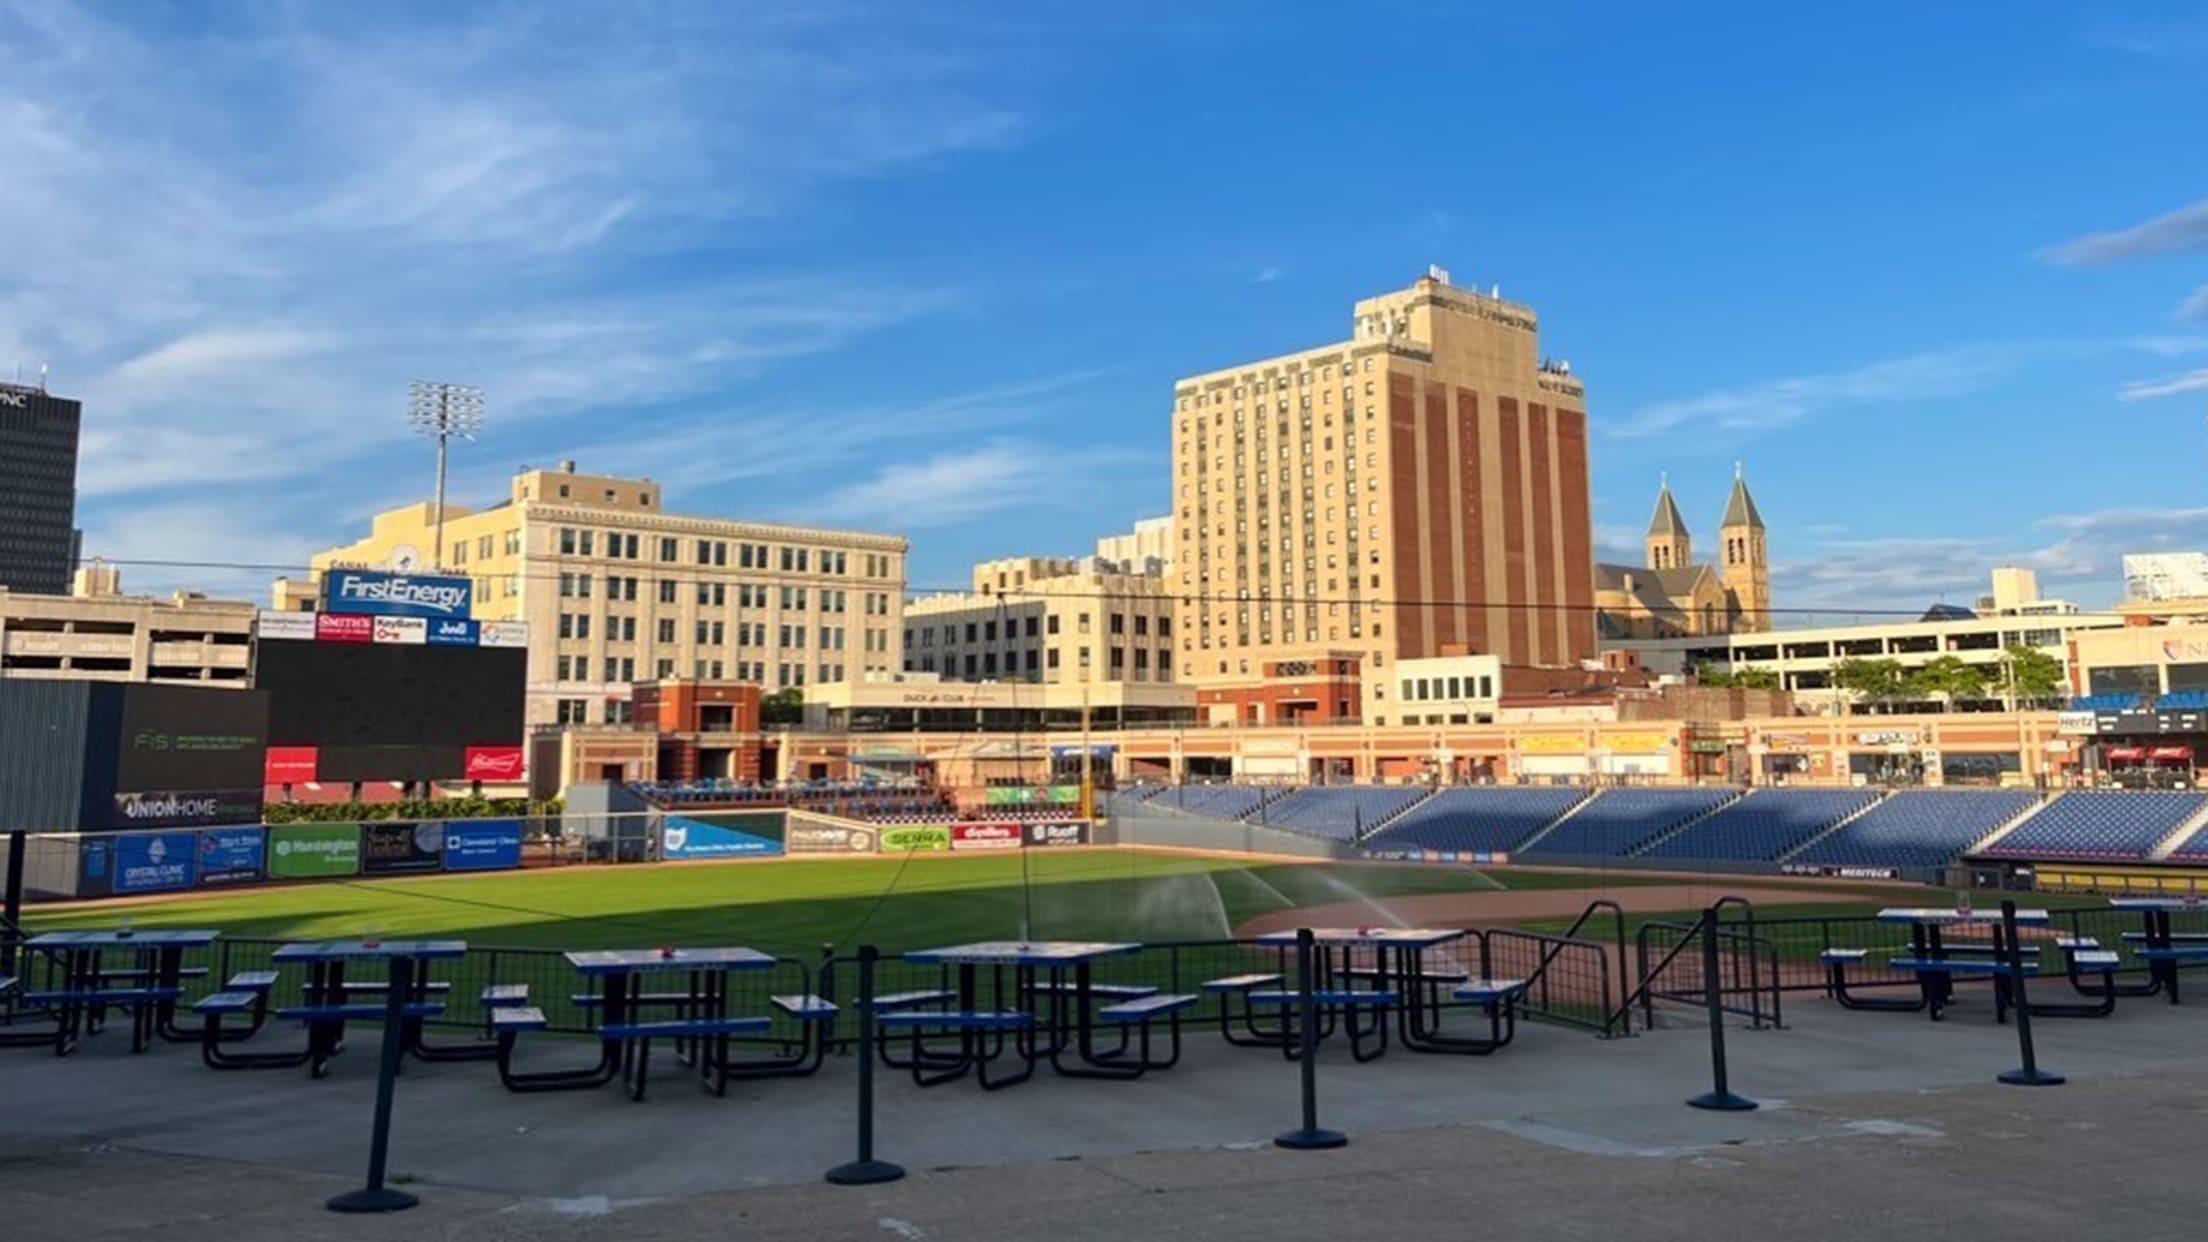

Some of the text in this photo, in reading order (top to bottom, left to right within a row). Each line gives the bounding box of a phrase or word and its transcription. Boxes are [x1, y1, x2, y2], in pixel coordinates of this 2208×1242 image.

[341, 575, 468, 608] FirstEnergy
[376, 619, 423, 629] KeyBank
[2061, 717, 2093, 729] Hertz
[1048, 826, 1078, 837] Ruoff
[292, 840, 357, 853] Huntington
